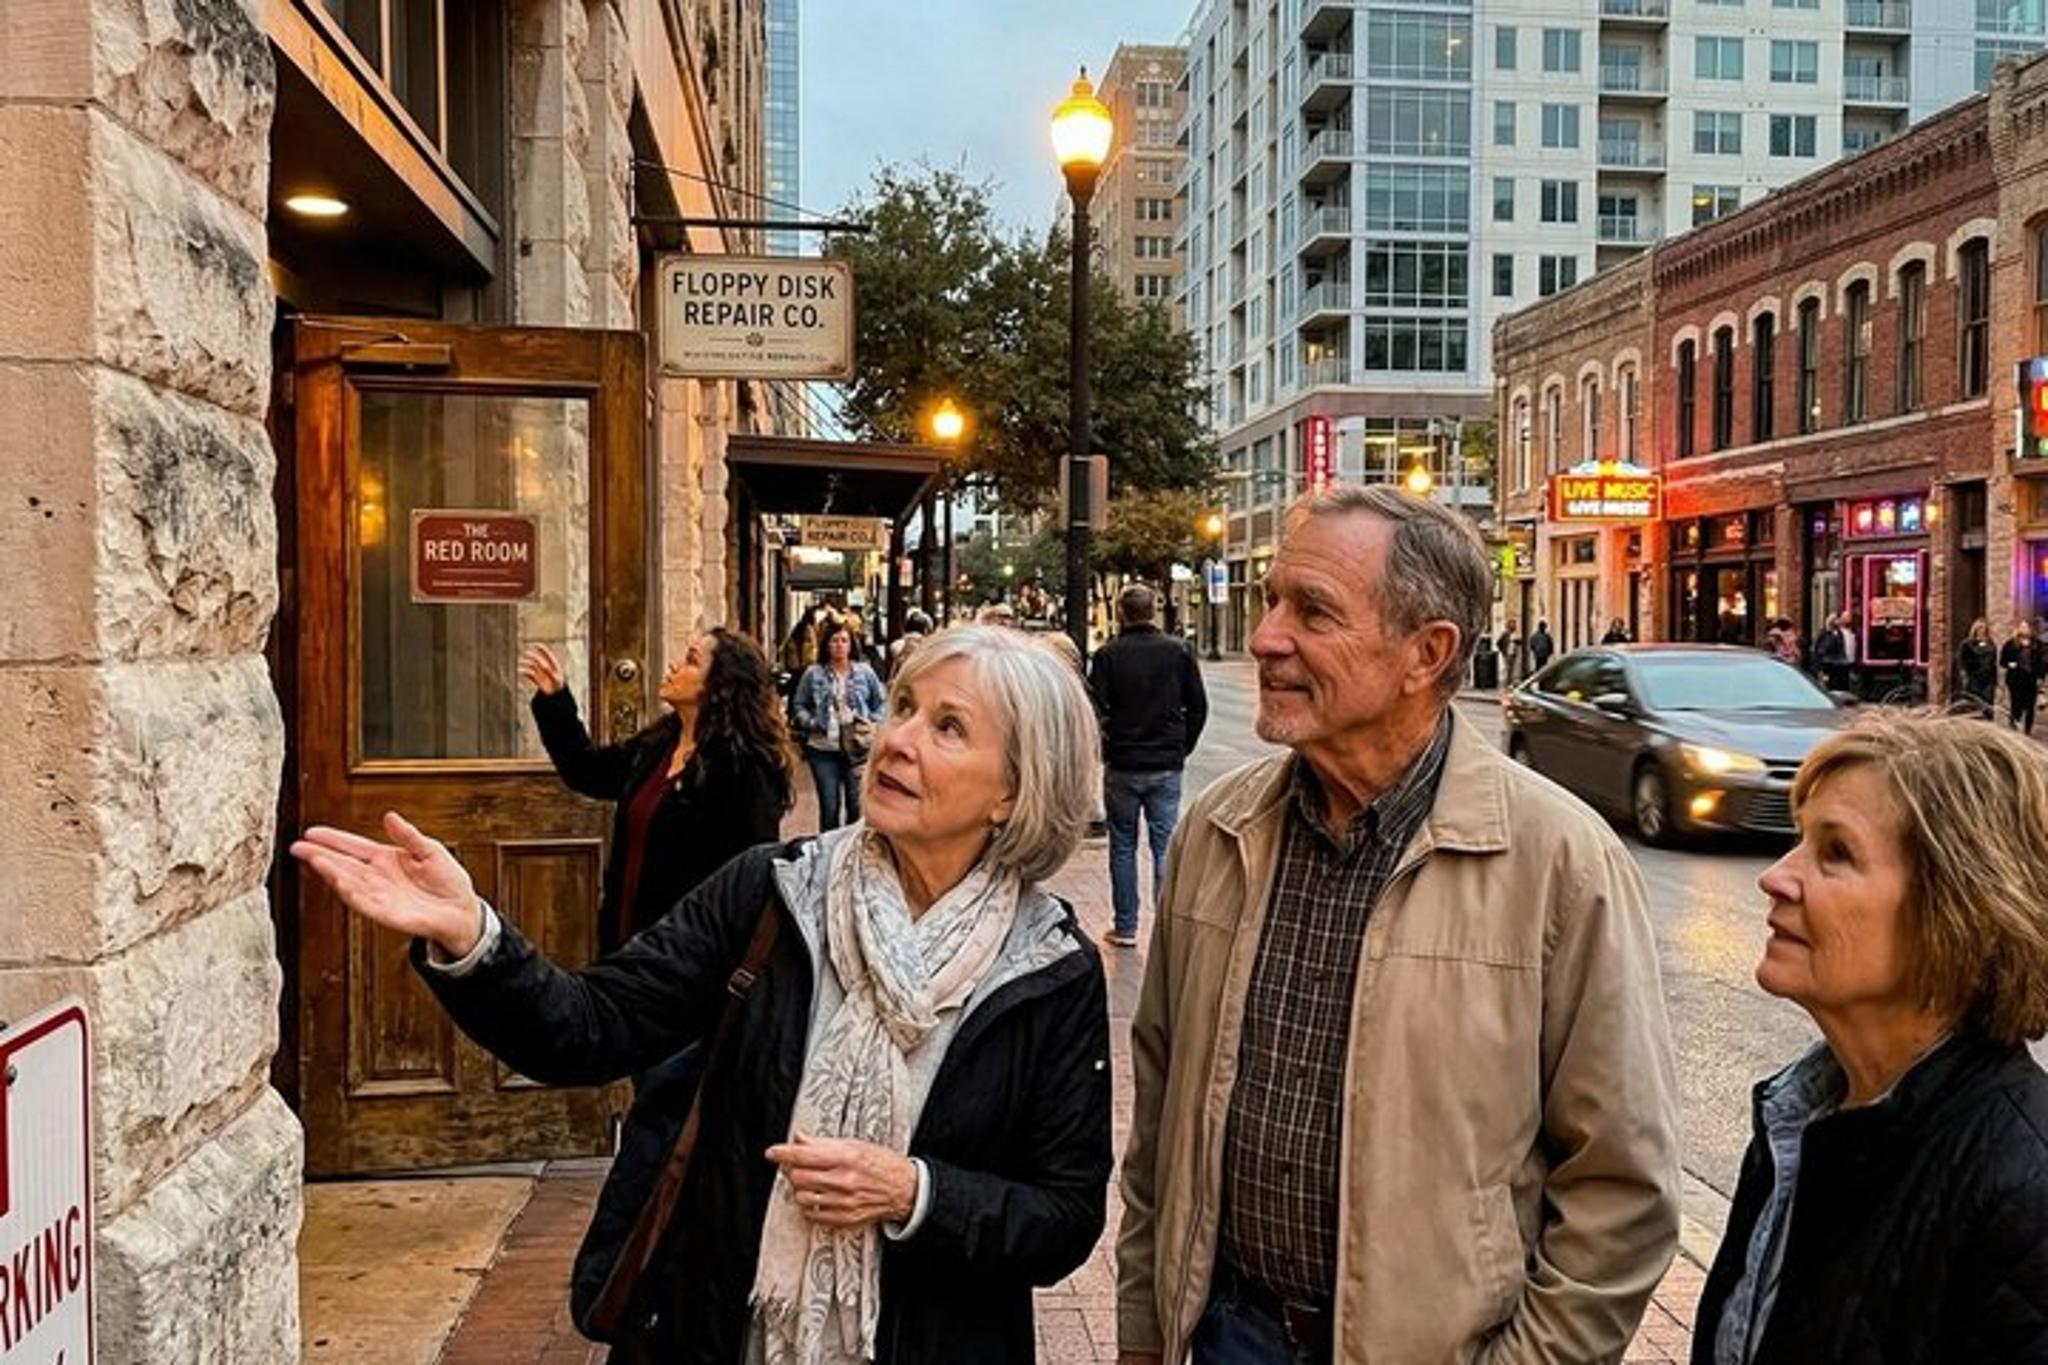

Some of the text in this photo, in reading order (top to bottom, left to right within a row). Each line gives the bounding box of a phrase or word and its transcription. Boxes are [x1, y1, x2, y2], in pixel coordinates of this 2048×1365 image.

[672, 272, 835, 299] FLOPPY DISK
[684, 301, 825, 328] REPAIR CO.
[1563, 481, 1656, 499] LIVE MUSIC
[463, 523, 489, 538] THE
[424, 540, 527, 562] RED ROOM
